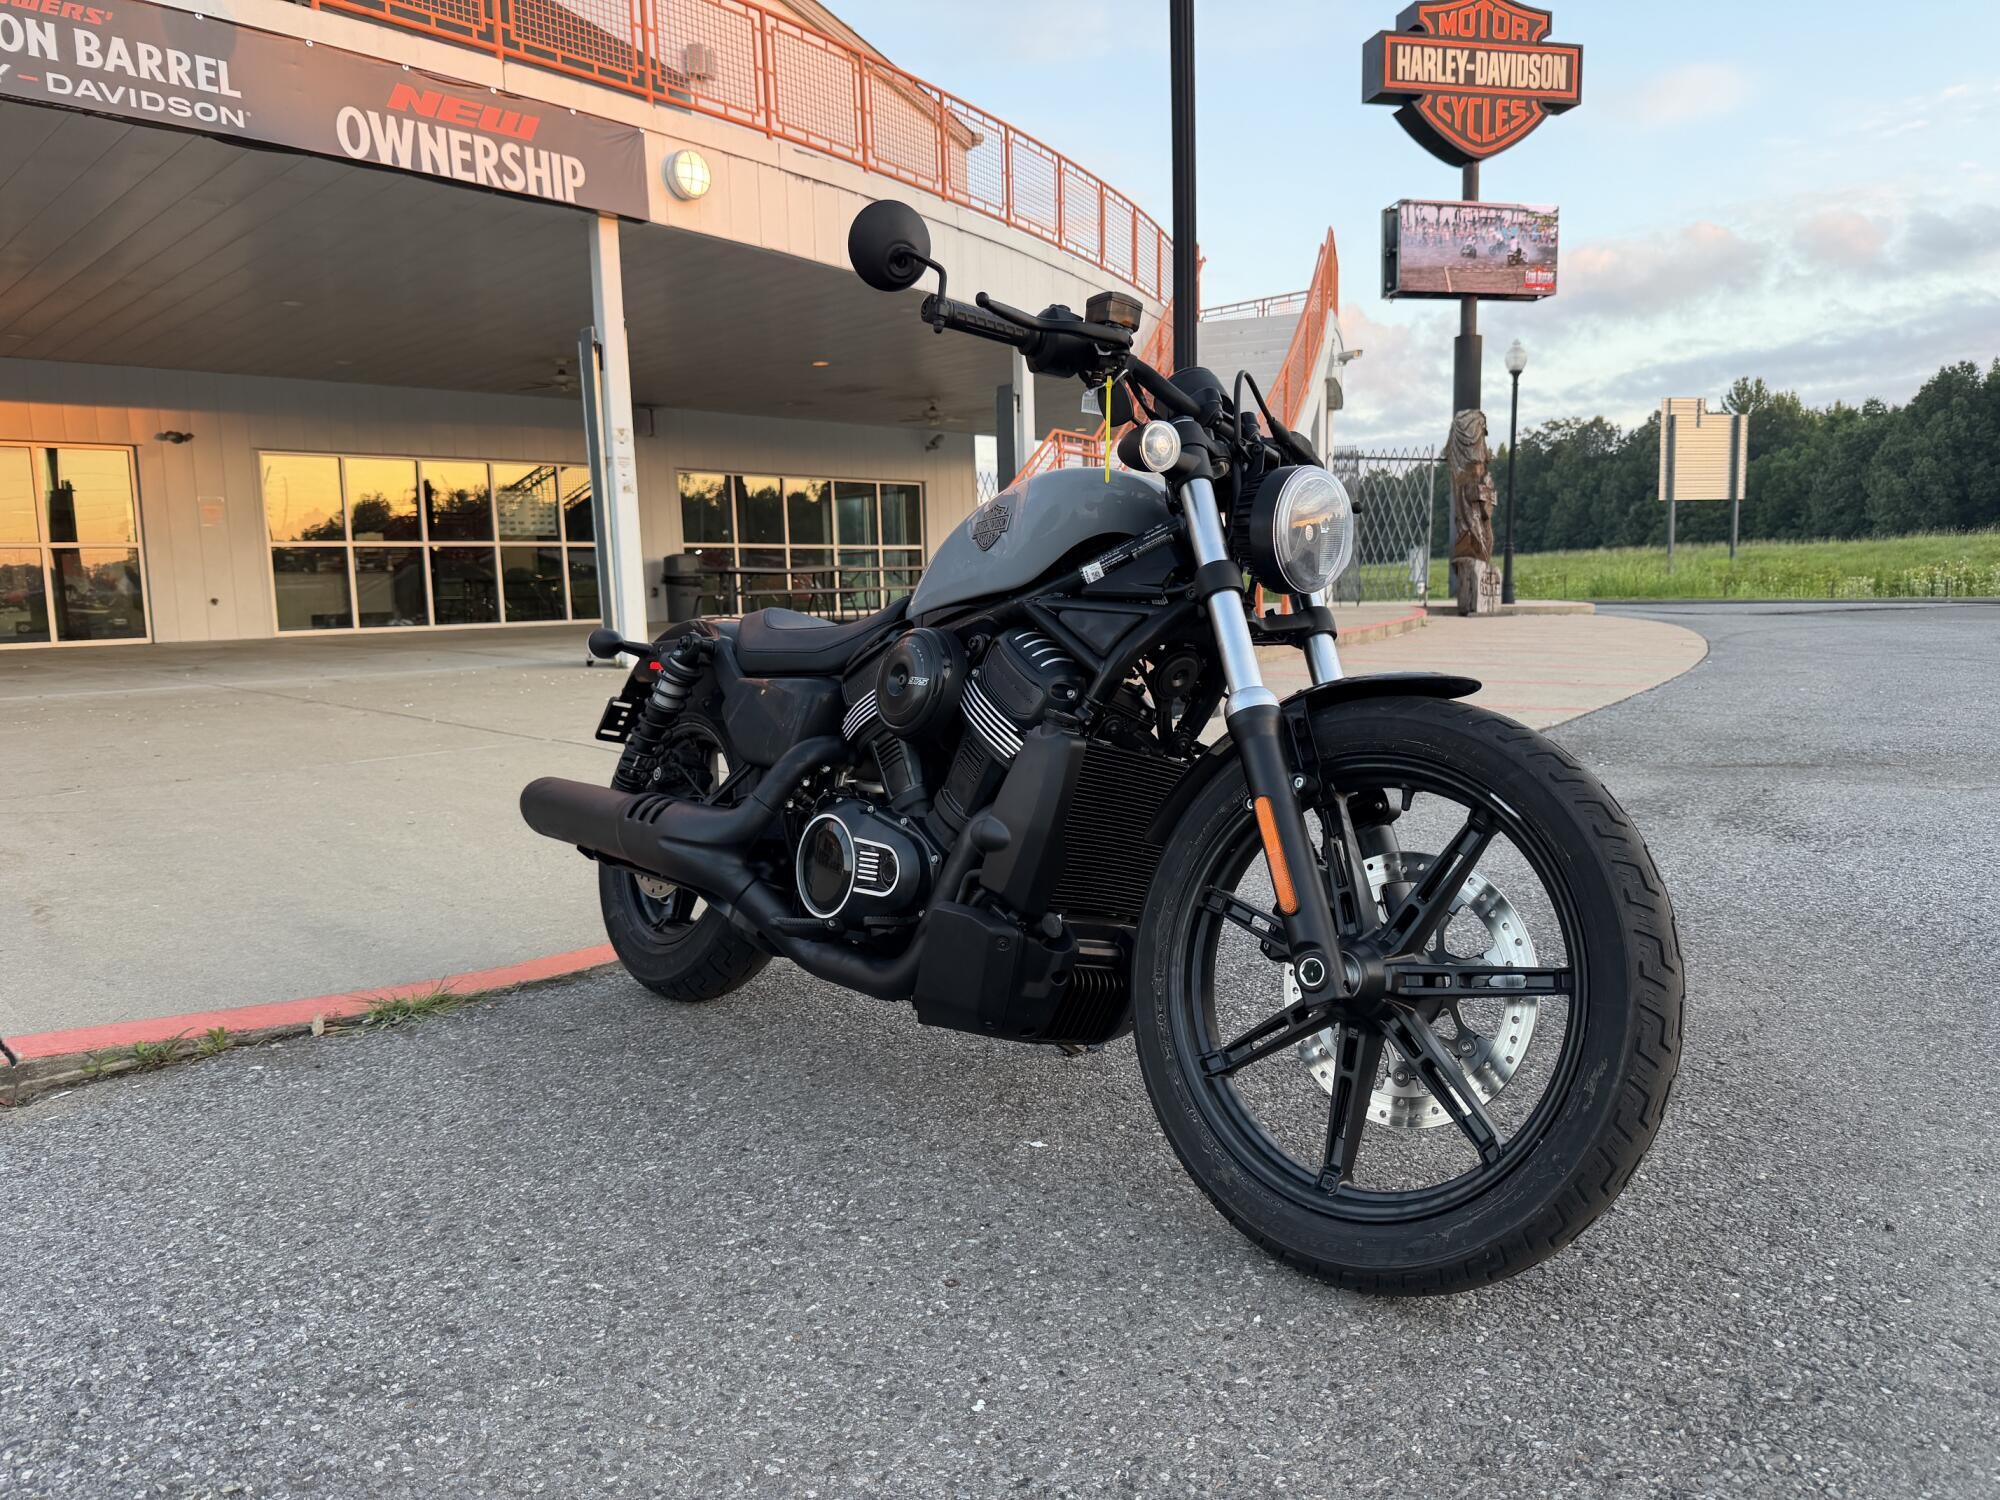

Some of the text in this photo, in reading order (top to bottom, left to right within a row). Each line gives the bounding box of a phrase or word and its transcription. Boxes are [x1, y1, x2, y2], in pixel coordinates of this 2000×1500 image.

[1439, 0, 1529, 41] MOTOR
[73, 27, 242, 99] BARREL
[1396, 45, 1567, 90] HARLEY-DAVIDSON
[386, 82, 540, 142] NEW
[1436, 95, 1528, 143] CYCLES
[336, 106, 586, 203] OWNERSHIP
